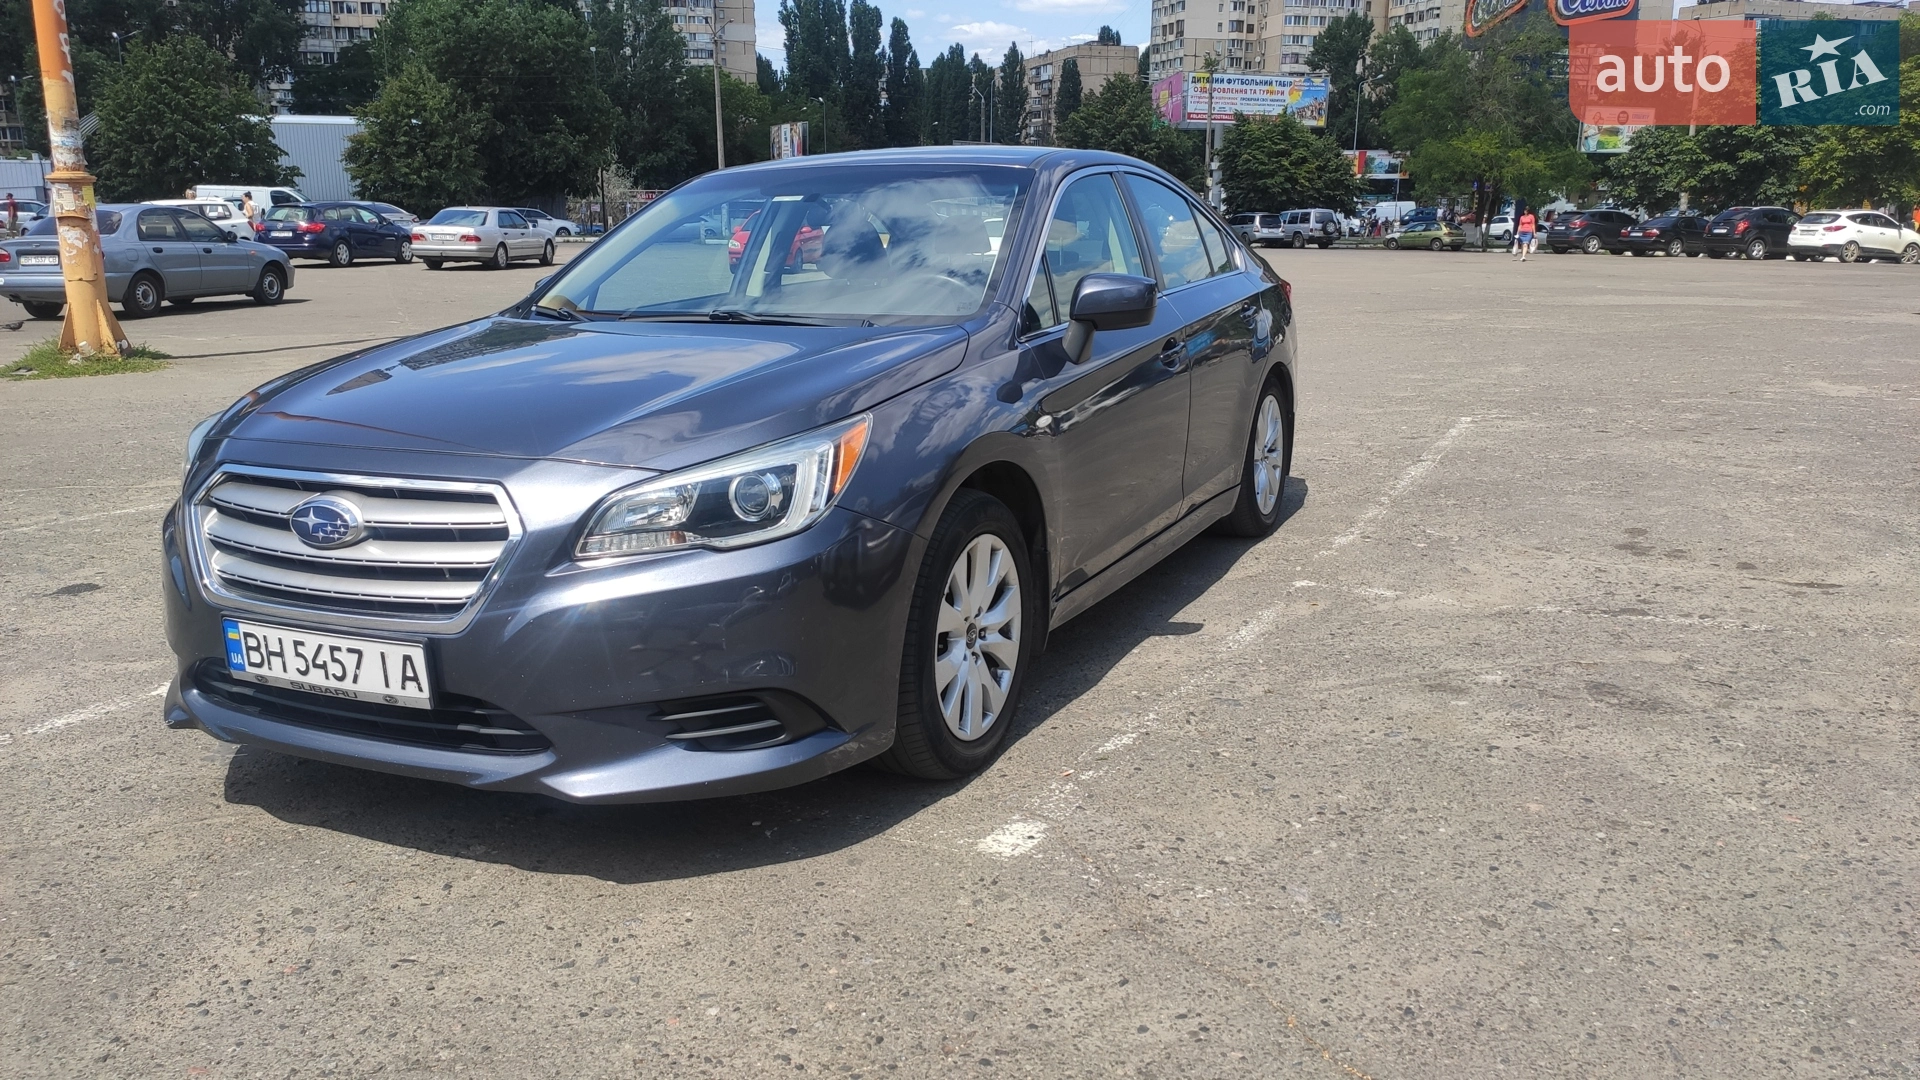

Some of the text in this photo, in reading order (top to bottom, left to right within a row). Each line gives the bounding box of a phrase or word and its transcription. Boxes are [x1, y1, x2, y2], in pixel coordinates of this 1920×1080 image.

[1226, 77, 1273, 87] ФУТБОЛЬНИЙ
[1193, 86, 1248, 95] ОЗДРОВЛЕННЯ
[231, 652, 244, 665] UA
[242, 631, 424, 693] BH 5457 IA
[289, 681, 358, 699] SUBARU
